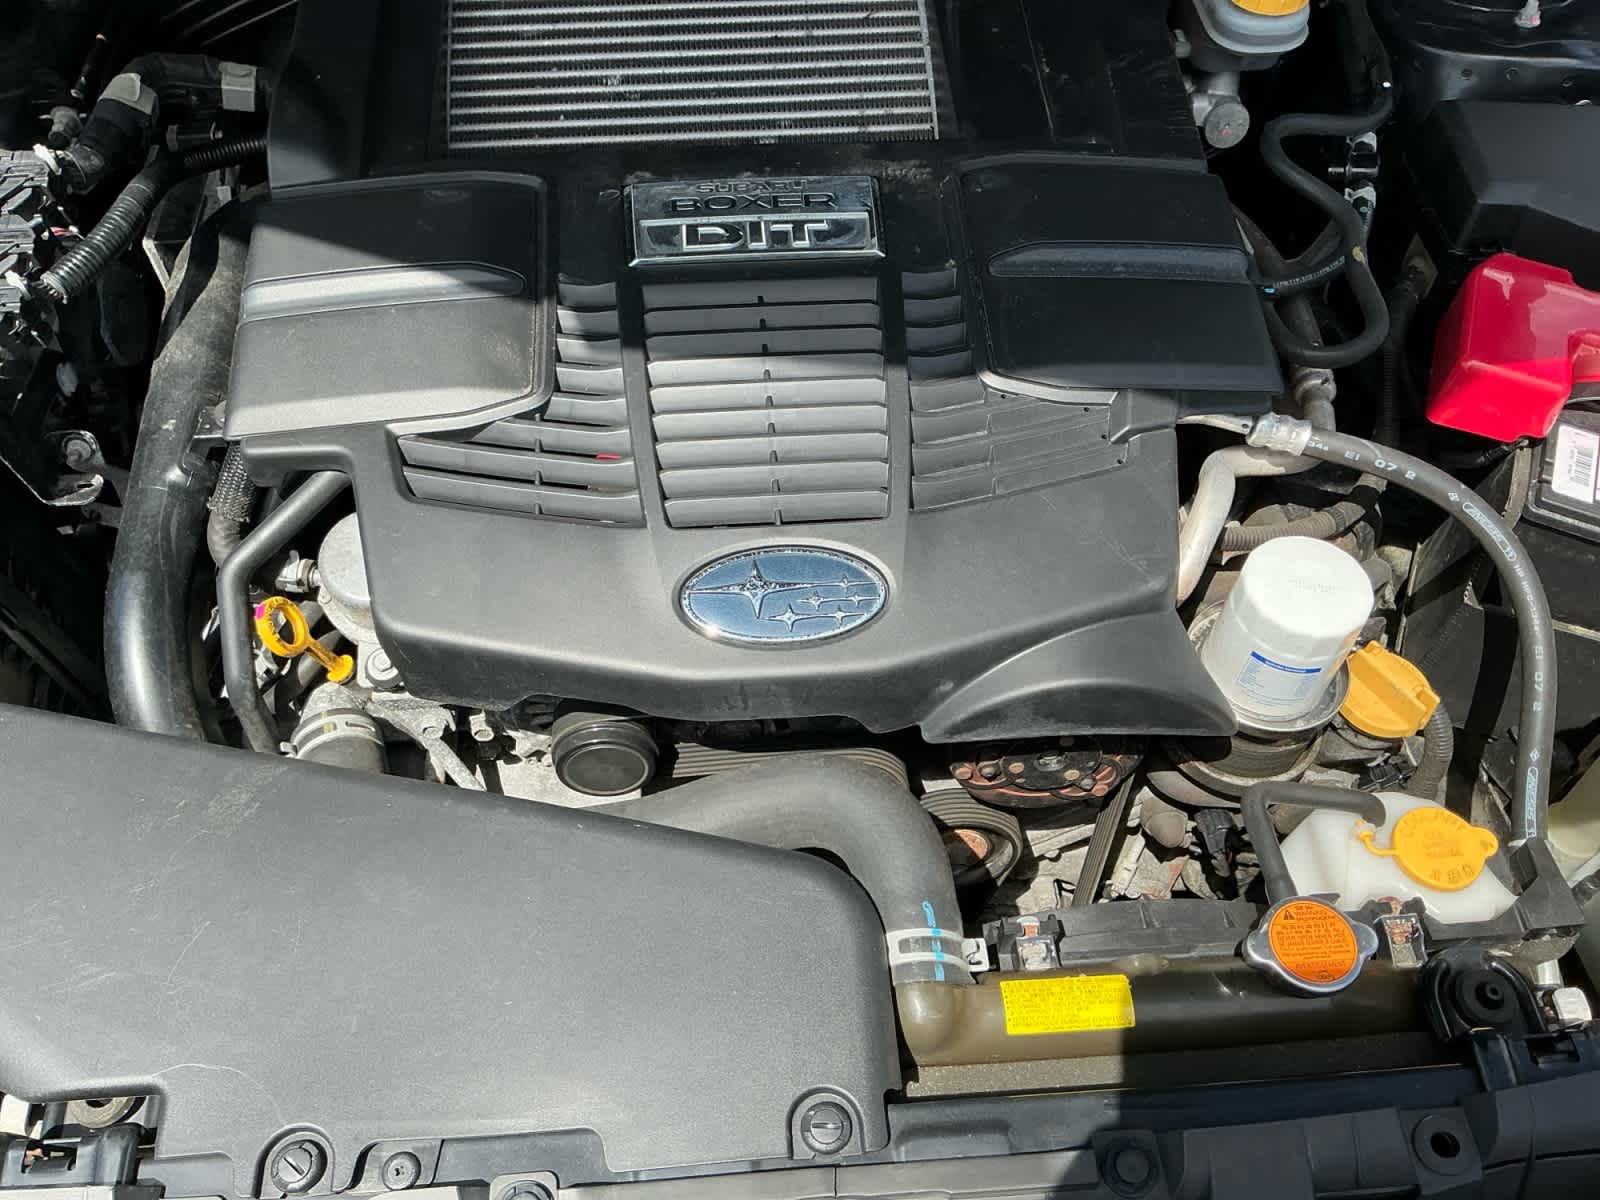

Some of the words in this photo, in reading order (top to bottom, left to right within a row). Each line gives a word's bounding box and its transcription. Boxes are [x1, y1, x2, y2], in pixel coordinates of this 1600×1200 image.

[696, 179, 807, 193] SUBARU
[671, 191, 839, 212] BOXER
[681, 219, 829, 252] DIT
[1374, 459, 1398, 471] 07
